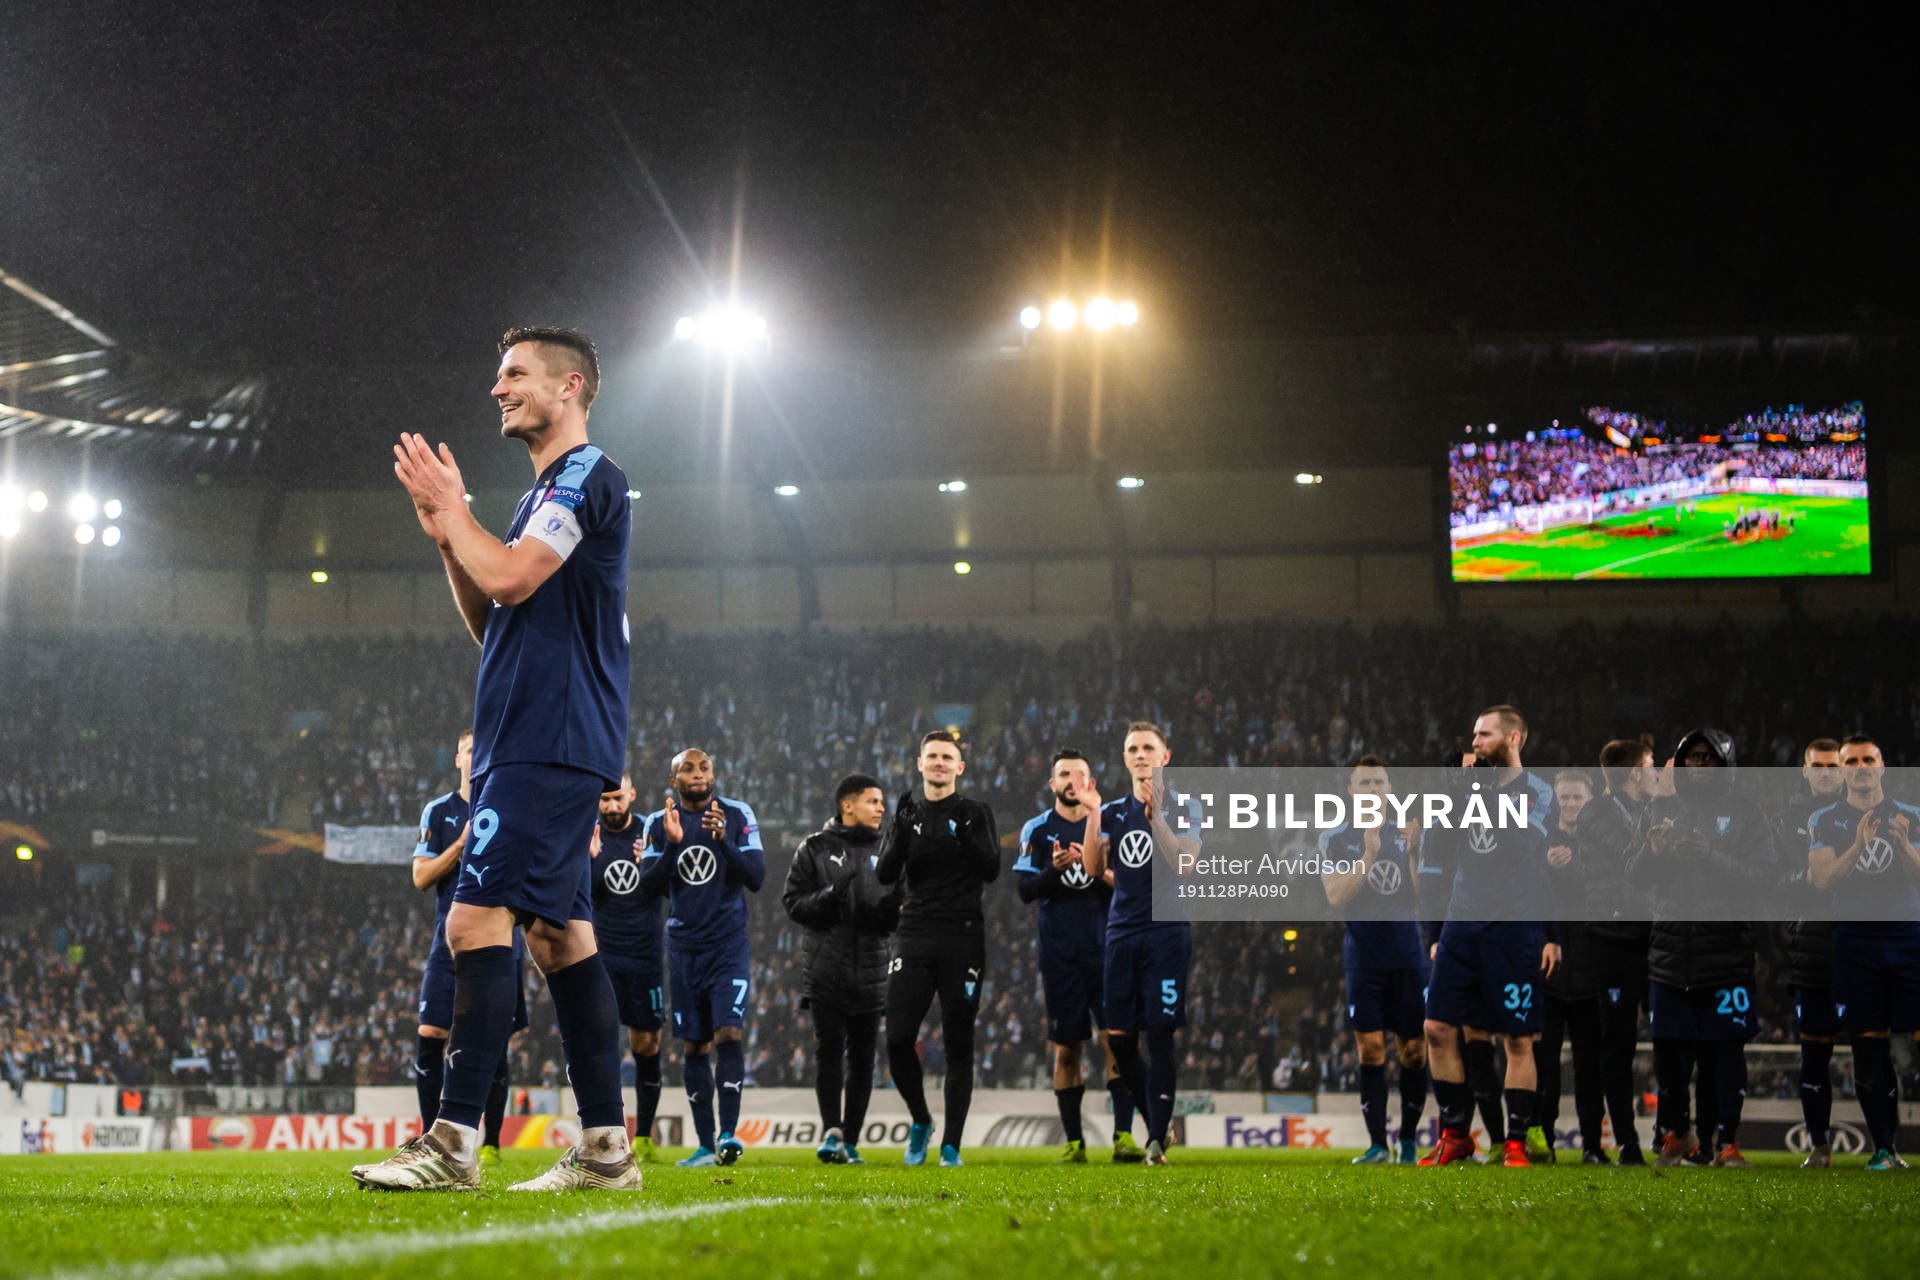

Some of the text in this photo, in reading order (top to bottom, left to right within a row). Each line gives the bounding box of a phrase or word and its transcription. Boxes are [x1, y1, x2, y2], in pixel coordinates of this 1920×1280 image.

[554, 489, 585, 502] RESPECT
[471, 808, 499, 856] 9
[732, 979, 748, 1005] 7
[1161, 979, 1178, 1005] 5
[1503, 983, 1533, 1010] 32
[1715, 986, 1750, 1014] 20
[266, 1115, 421, 1151] AMSTE
[1225, 1116, 1332, 1149] FedEx
